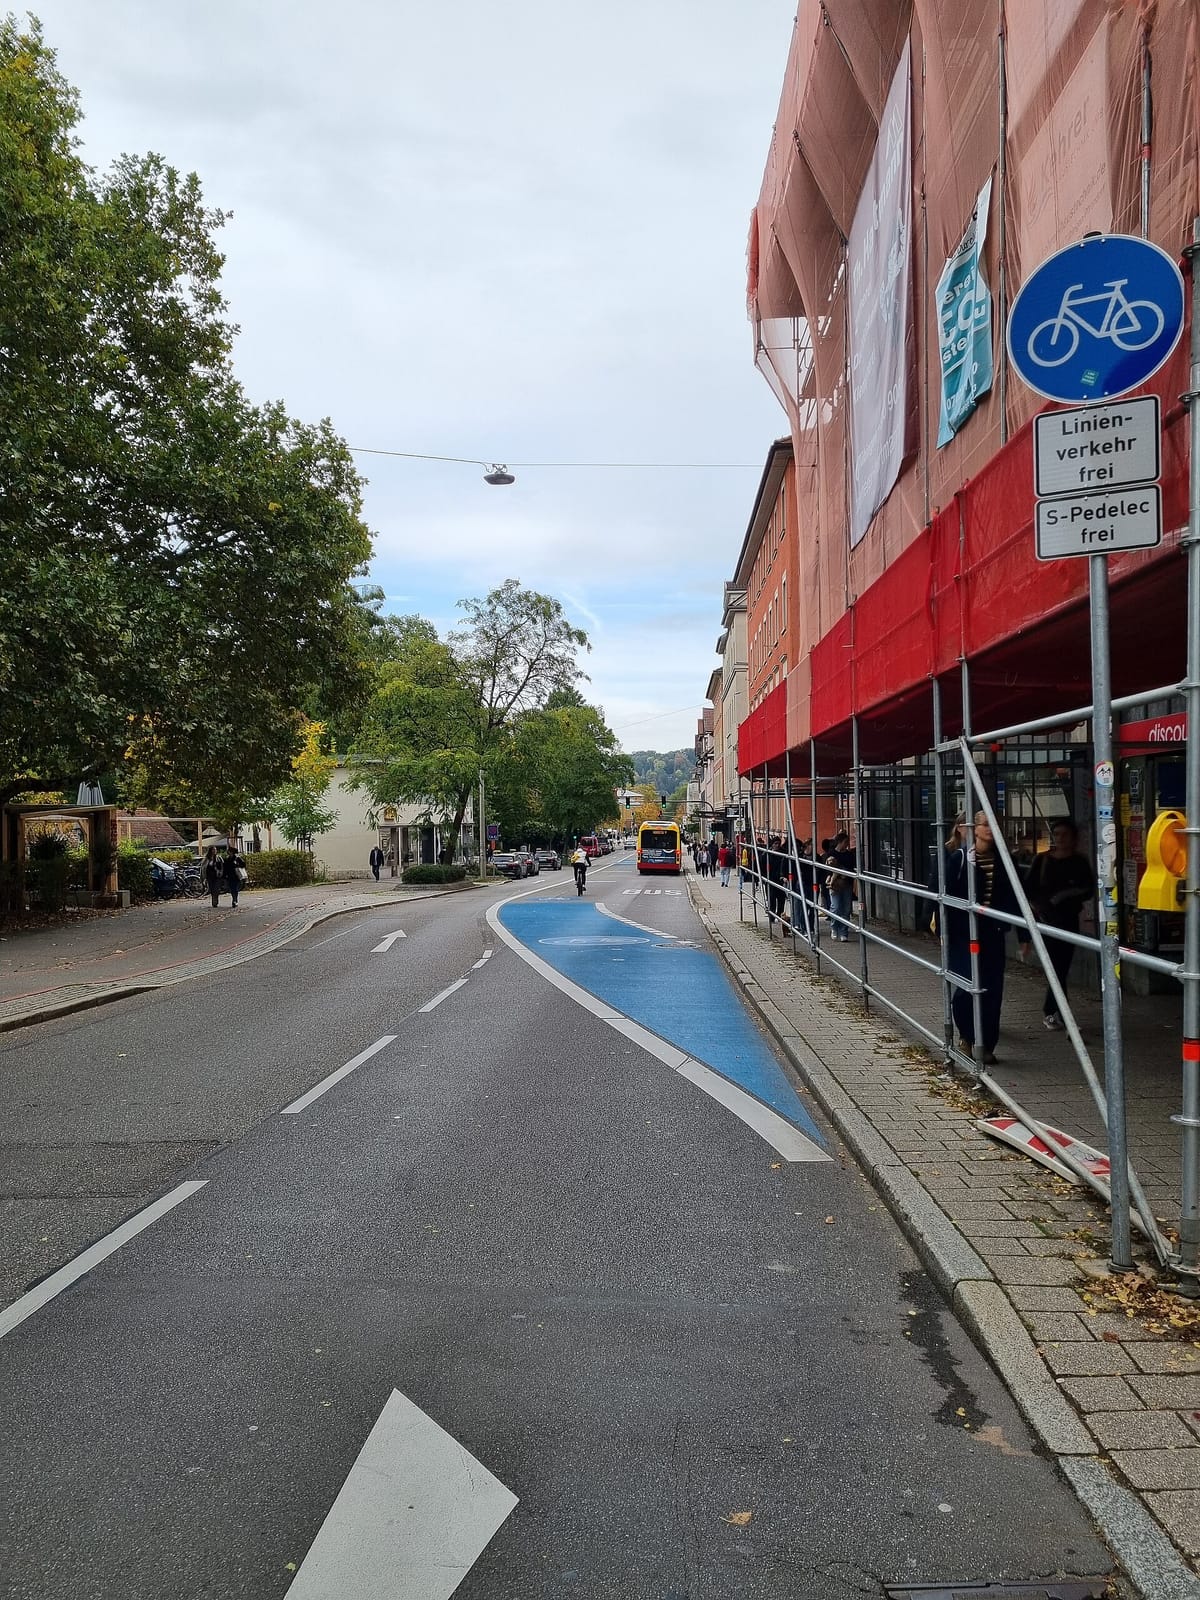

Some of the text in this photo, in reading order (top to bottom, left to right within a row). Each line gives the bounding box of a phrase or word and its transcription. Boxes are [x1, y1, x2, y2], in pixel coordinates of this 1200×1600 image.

[1062, 415, 1133, 435] Linien-
[1056, 436, 1136, 461] verkehr
[1079, 462, 1114, 482] frei
[1046, 499, 1150, 525] S-Pedelec
[1080, 524, 1115, 544] frei
